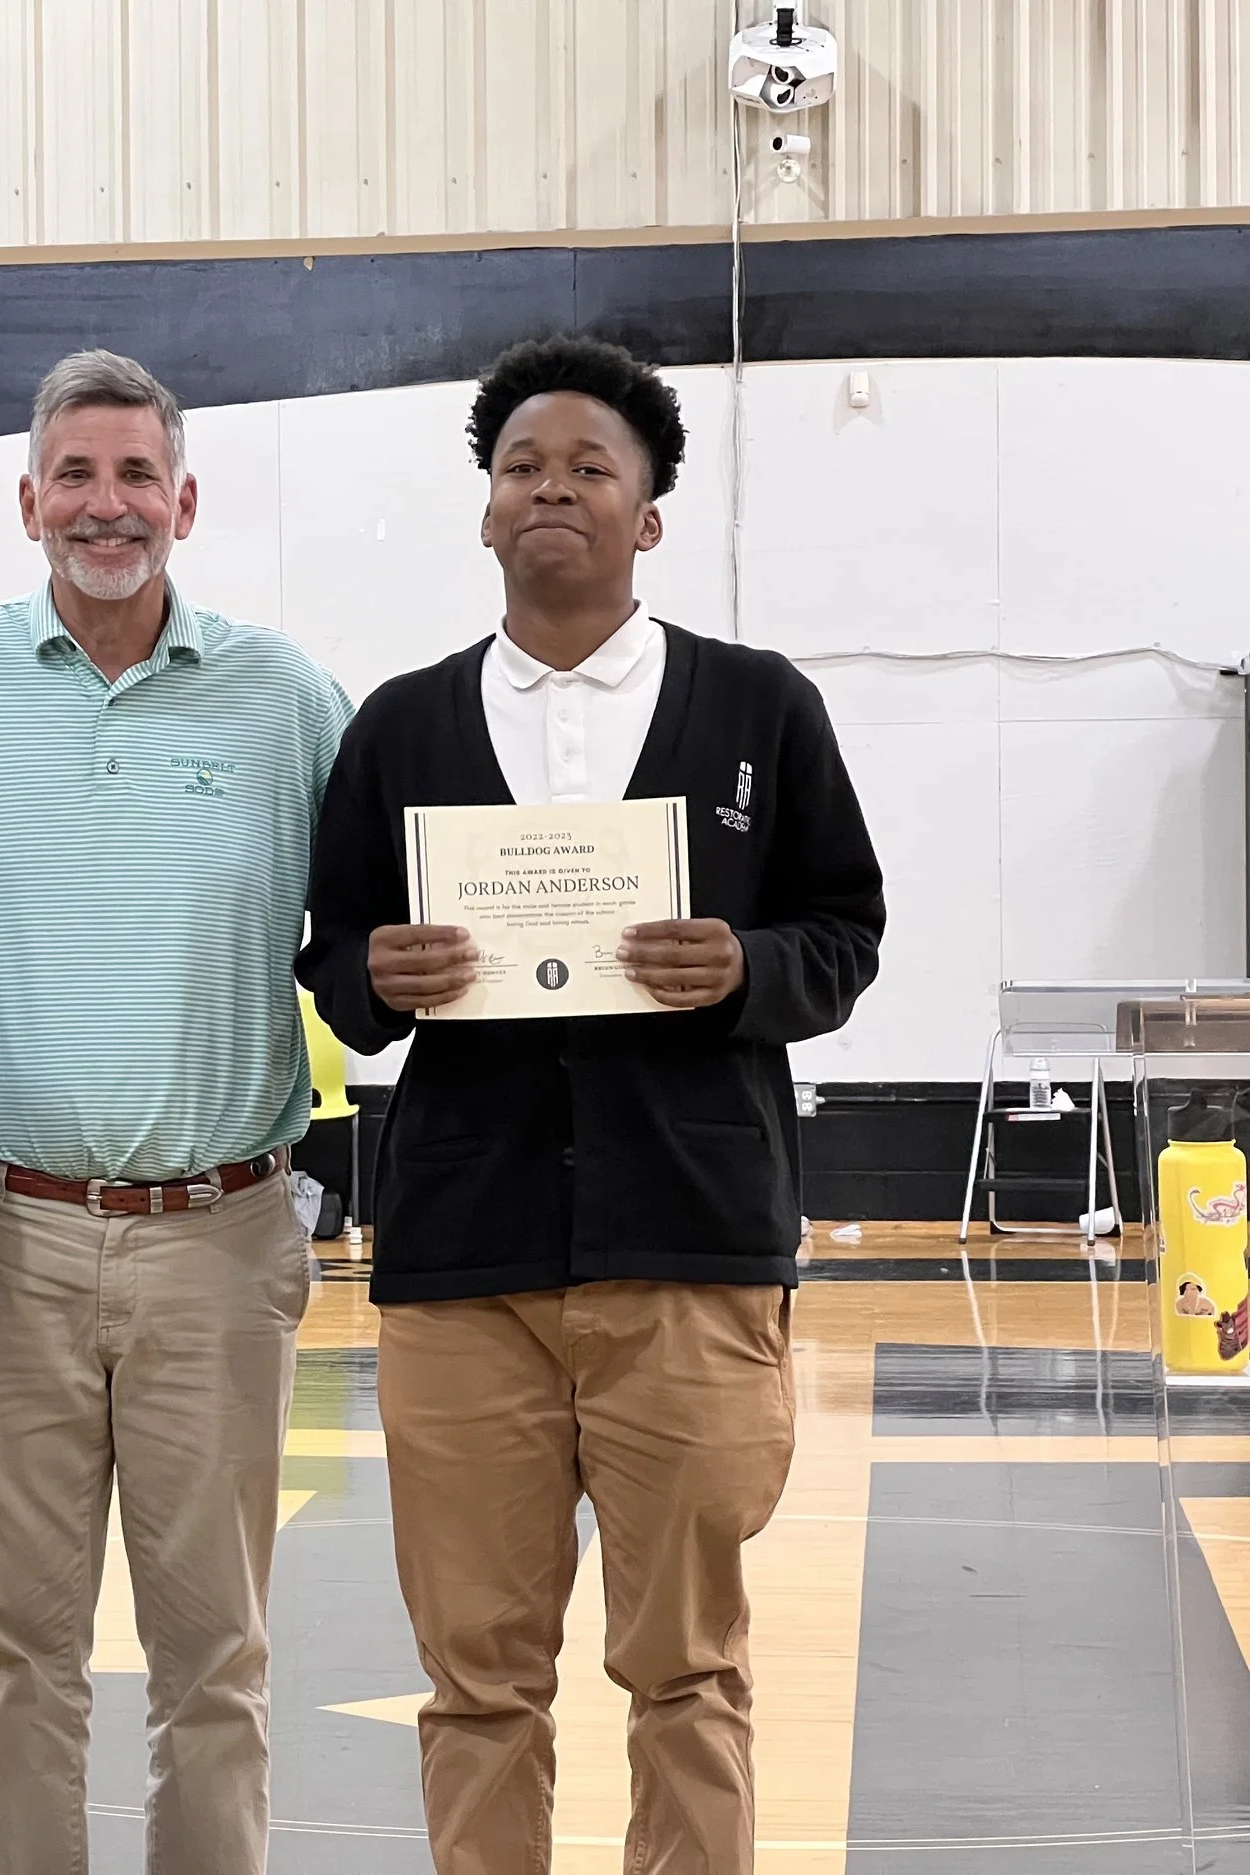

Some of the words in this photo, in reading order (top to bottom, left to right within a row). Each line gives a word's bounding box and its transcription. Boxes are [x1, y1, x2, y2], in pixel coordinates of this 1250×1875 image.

[170, 758, 236, 773] SUNBELT
[500, 846, 551, 857] BULLDOG
[553, 845, 595, 855] AWARD
[458, 881, 531, 900] JORDAN
[536, 876, 639, 894] ANDERSON
